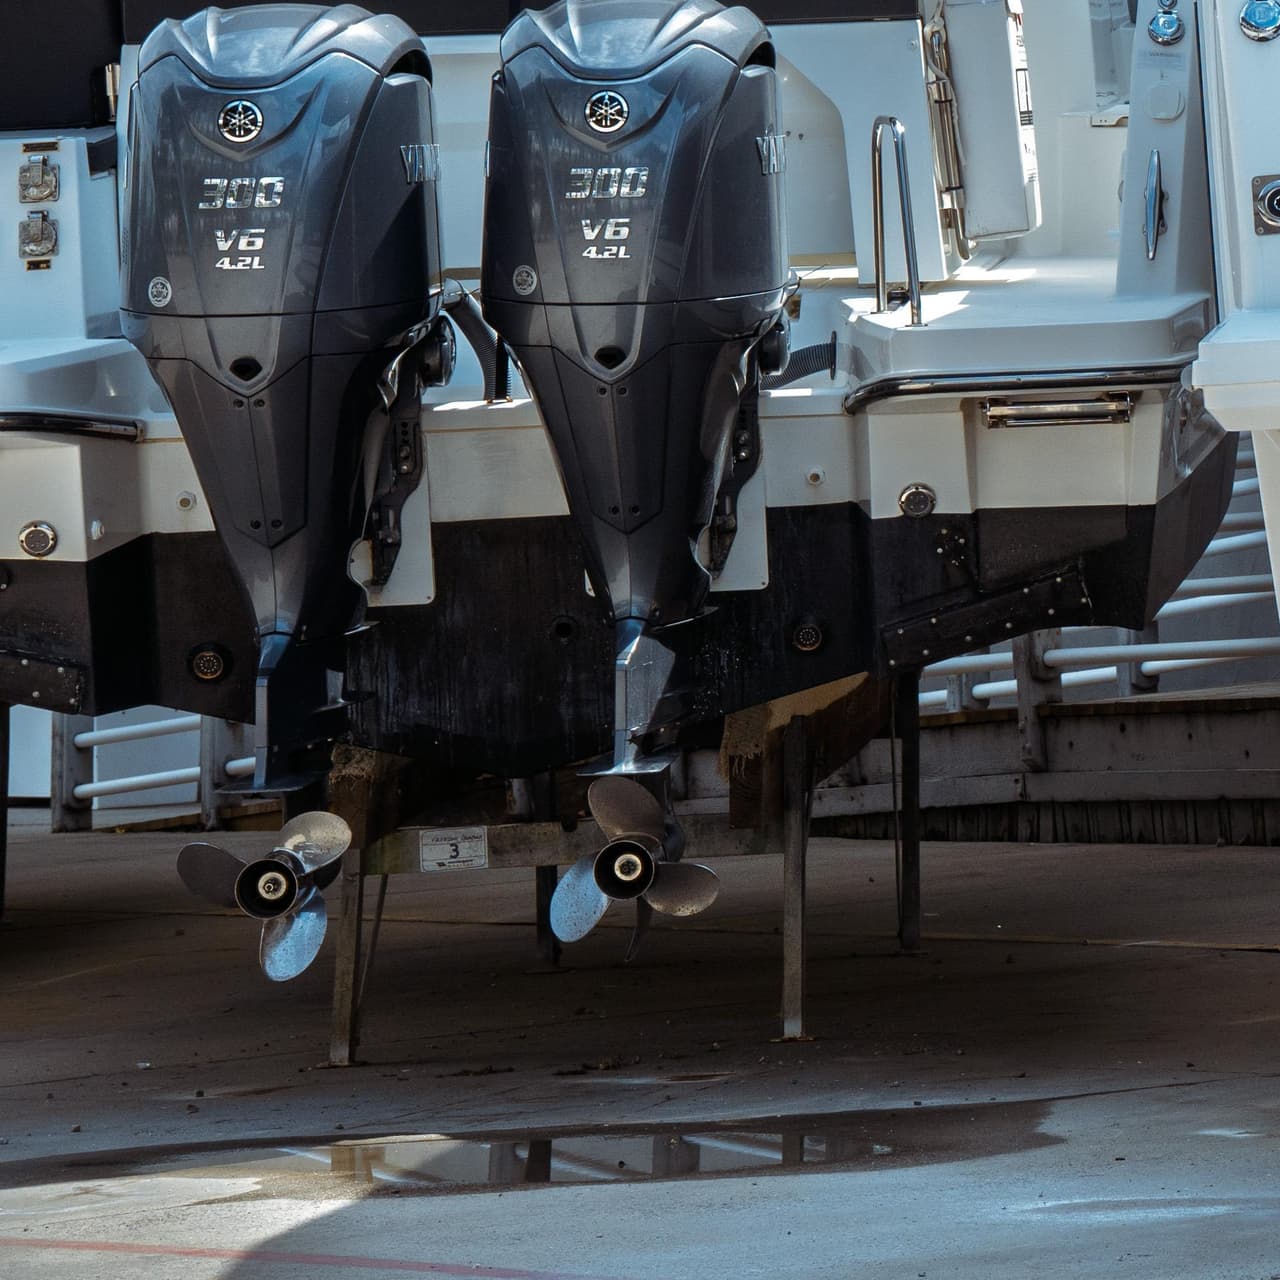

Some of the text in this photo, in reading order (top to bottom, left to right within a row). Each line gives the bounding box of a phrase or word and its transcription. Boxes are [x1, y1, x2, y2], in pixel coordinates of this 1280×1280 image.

[198, 176, 286, 210] 300
[565, 166, 649, 199] 300
[214, 228, 266, 251] V6
[581, 218, 631, 241] V6
[215, 256, 265, 270] 4.2L
[582, 246, 631, 259] 4.2L
[449, 843, 460, 859] 3
